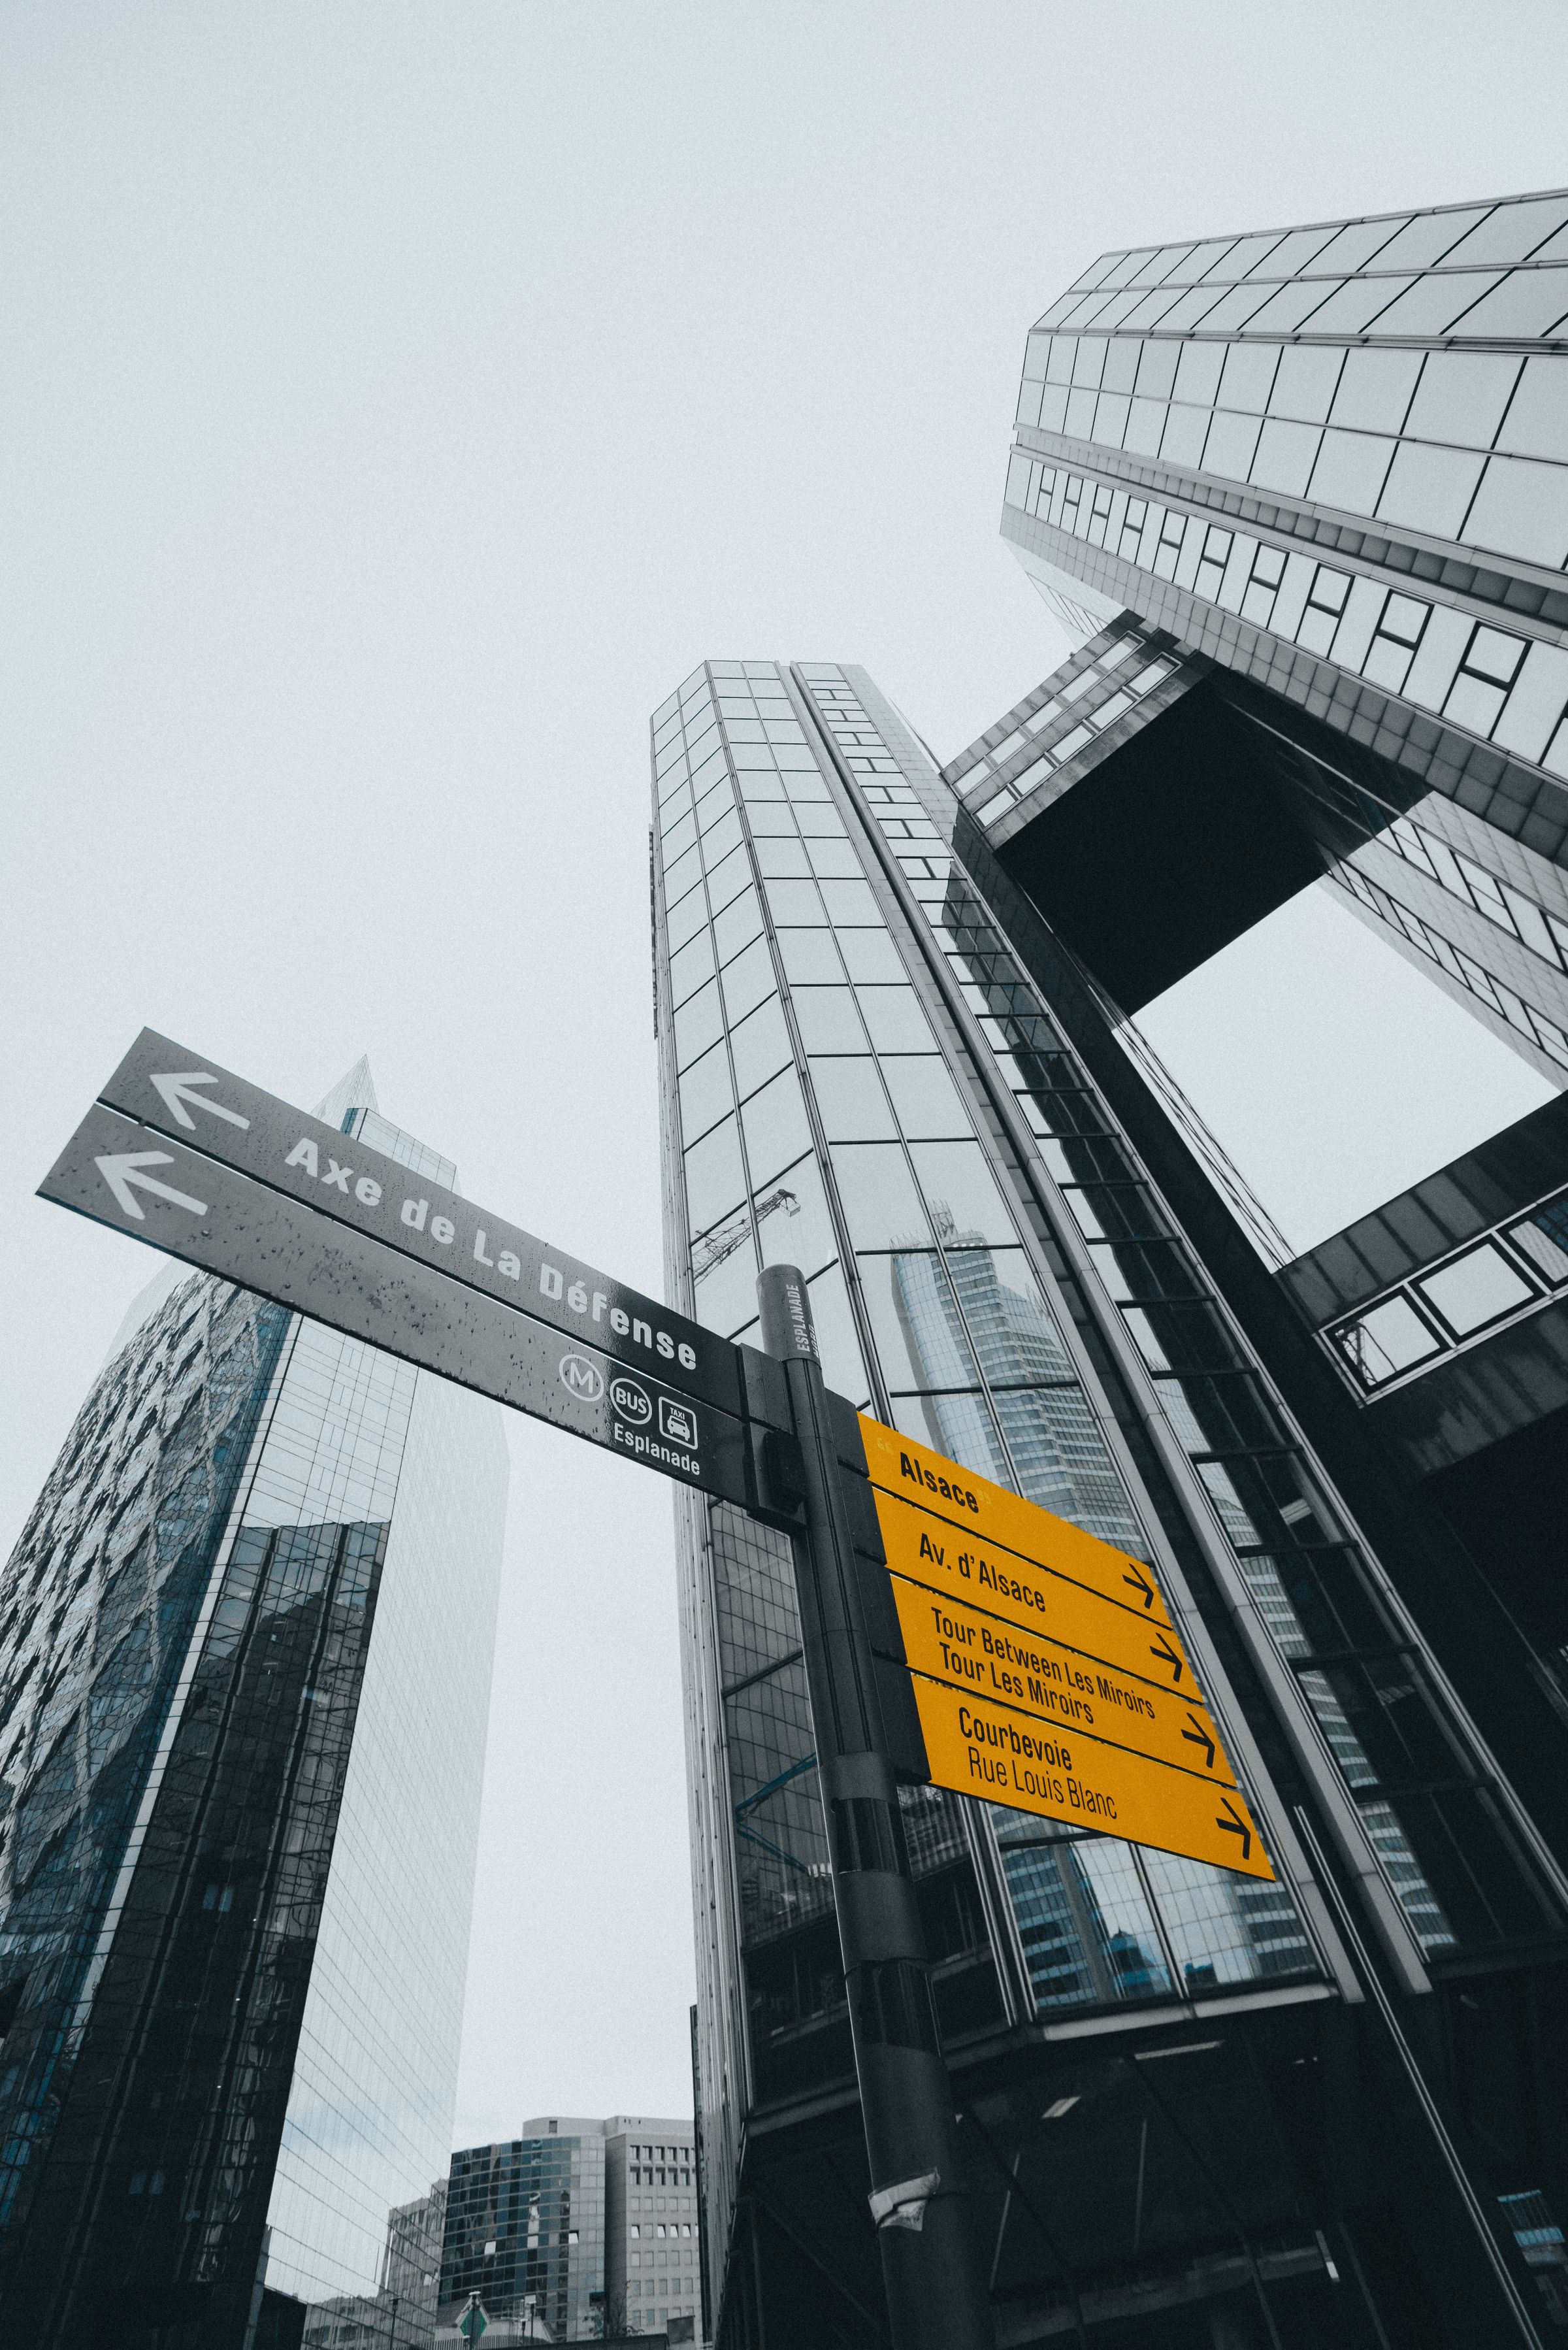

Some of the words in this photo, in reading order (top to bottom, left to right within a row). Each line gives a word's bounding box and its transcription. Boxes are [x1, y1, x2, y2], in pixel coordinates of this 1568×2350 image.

[285, 1137, 383, 1206] Axe
[400, 1199, 456, 1245] de
[473, 1229, 521, 1281] La
[539, 1262, 696, 1370] Défense
[786, 1284, 810, 1352] ESPLANADE
[615, 1387, 647, 1414] BUS
[670, 1407, 685, 1420] TAXI
[614, 1422, 700, 1476] Esplanade
[900, 1451, 979, 1514] Alsace
[919, 1532, 951, 1572] Av.
[930, 1606, 976, 1646] Tour
[981, 1627, 1062, 1682] Between
[1064, 1662, 1094, 1695] Les
[1096, 1676, 1155, 1719] Miroirs
[938, 1642, 985, 1682] Tour
[990, 1661, 1024, 1698] Les
[1027, 1676, 1094, 1724] Miroirs
[958, 1706, 1072, 1771] Courbevoie
[968, 1746, 1007, 1787] Rue
[1012, 1760, 1064, 1804] Louis
[1066, 1777, 1117, 1819] Blanc
